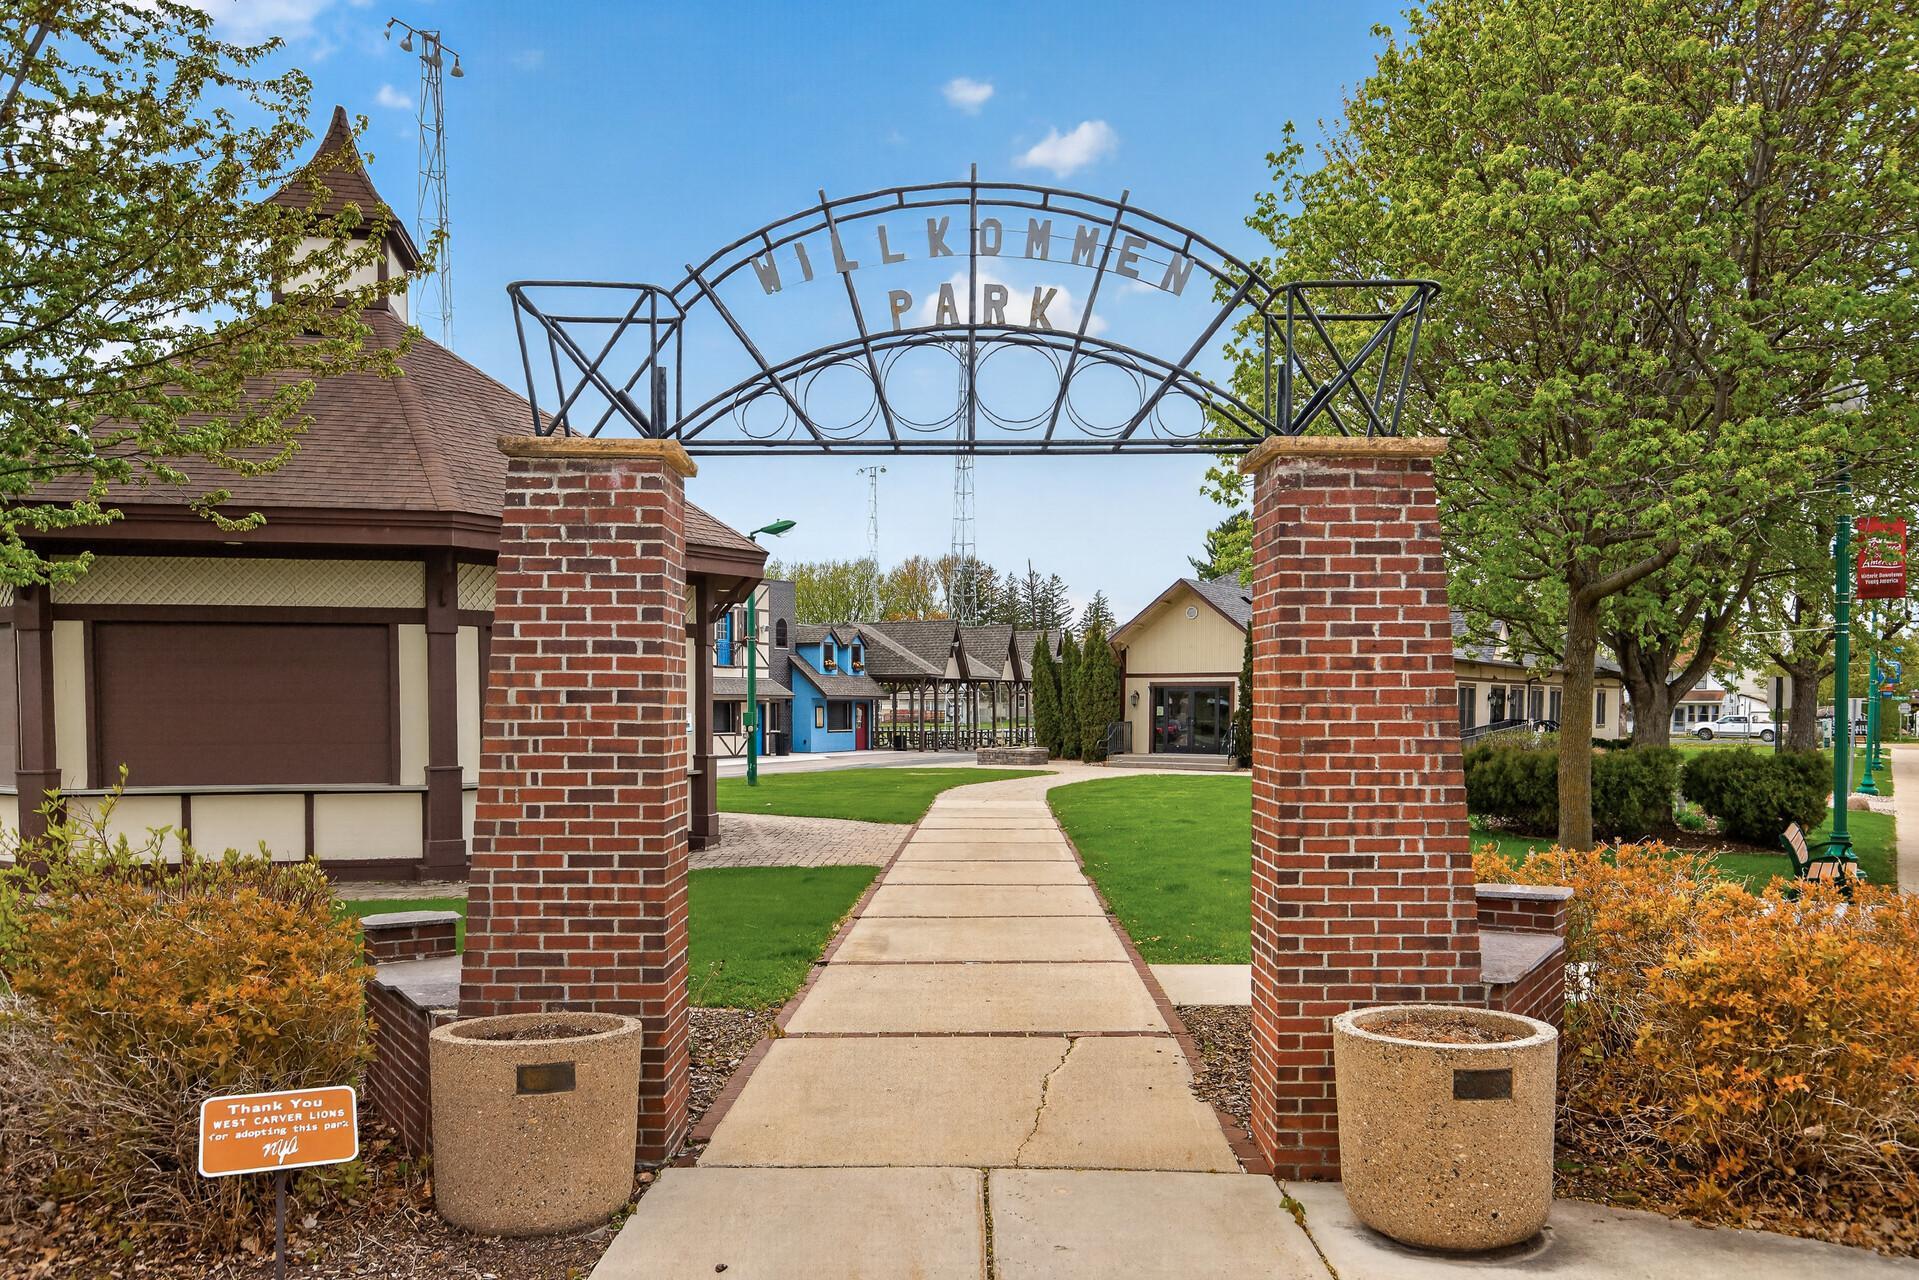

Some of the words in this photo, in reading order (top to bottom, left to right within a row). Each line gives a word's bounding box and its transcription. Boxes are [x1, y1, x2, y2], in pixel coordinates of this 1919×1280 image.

[750, 216, 1196, 296] WILLKOMMEN
[888, 282, 1057, 330] PARK
[227, 1101, 283, 1115] Thank
[290, 1098, 323, 1109] You
[213, 1118, 247, 1129] WEST
[254, 1113, 303, 1125] CARVER
[309, 1108, 345, 1120] LIONS
[208, 1132, 228, 1142] for
[235, 1126, 287, 1140] adopting
[293, 1123, 318, 1133] this
[324, 1120, 350, 1131] park
